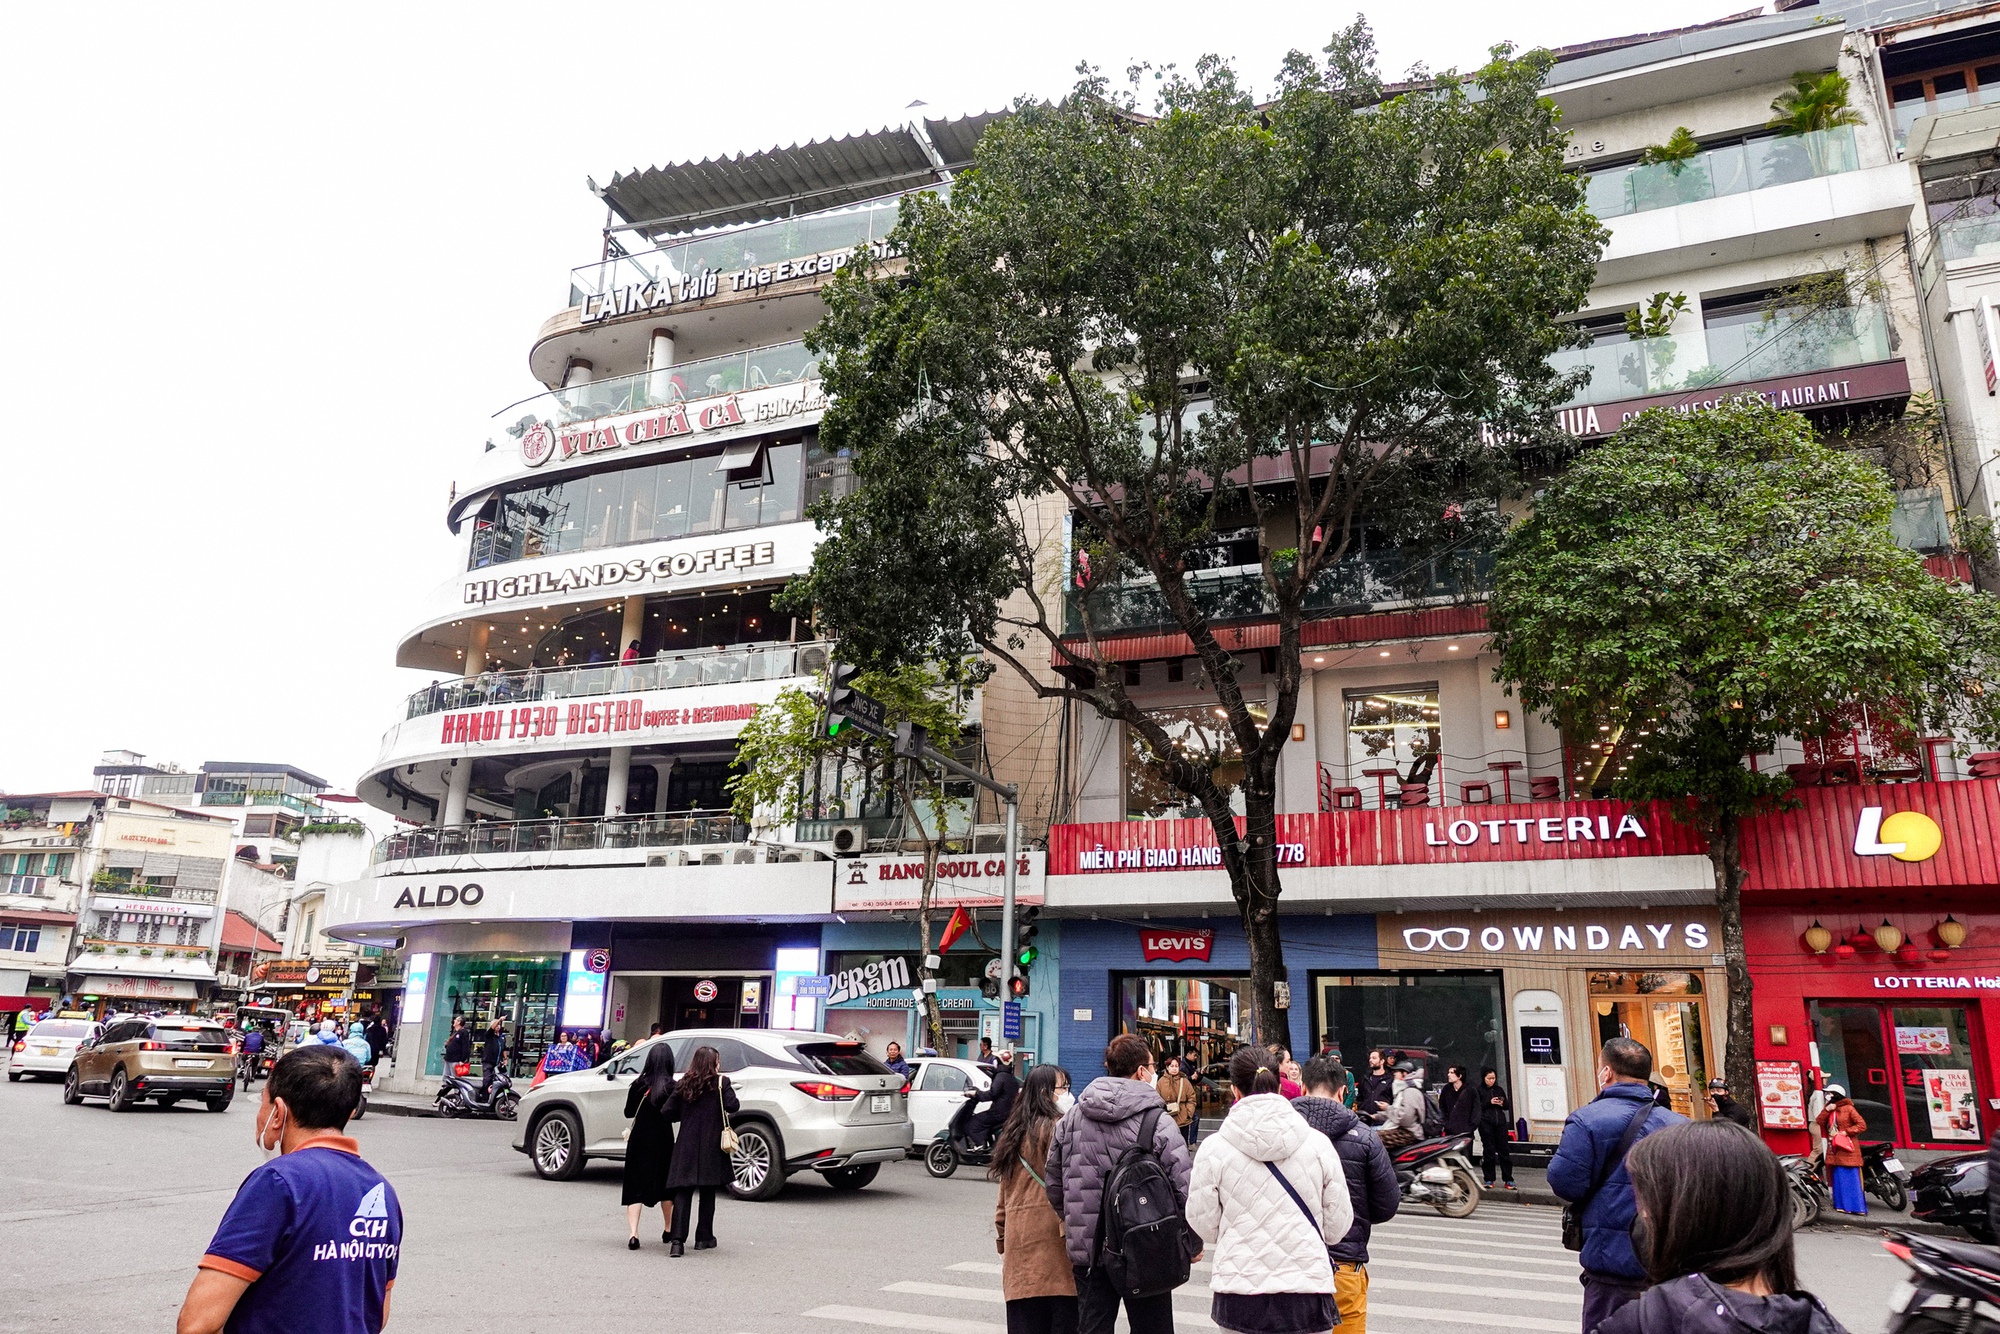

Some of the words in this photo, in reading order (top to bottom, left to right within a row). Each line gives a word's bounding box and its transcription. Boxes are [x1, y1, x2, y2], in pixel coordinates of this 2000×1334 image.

[579, 276, 673, 324] LAIKA
[678, 268, 722, 302] Café
[729, 267, 771, 292] The
[558, 425, 621, 460] VUA
[625, 403, 694, 445] CHẢ
[699, 393, 745, 430] CÁ
[463, 558, 646, 604] HIGHLANDS
[650, 541, 775, 579] COFFEE
[440, 709, 503, 744] HANOI
[508, 706, 558, 739] 1930
[566, 698, 643, 736] BISTRO
[643, 708, 679, 728] COFFEE
[681, 708, 689, 724] &
[1425, 814, 1647, 846] LOTTERIA
[878, 862, 926, 880] HANO
[936, 860, 982, 879] SOUL
[984, 853, 1031, 876] CAÉ
[1118, 846, 1142, 868] PHÍ
[1145, 848, 1178, 867] GIAO
[125, 903, 183, 913] HERBALIST
[393, 883, 485, 909] ALDO
[1480, 922, 1710, 951] OWNDAYS
[1873, 976, 1972, 989] LOTTERIA
[866, 997, 914, 1008] HOMEMADE
[942, 998, 973, 1009] CREAM
[313, 1239, 338, 1261] HÀ
[340, 1238, 364, 1262] NỘI
